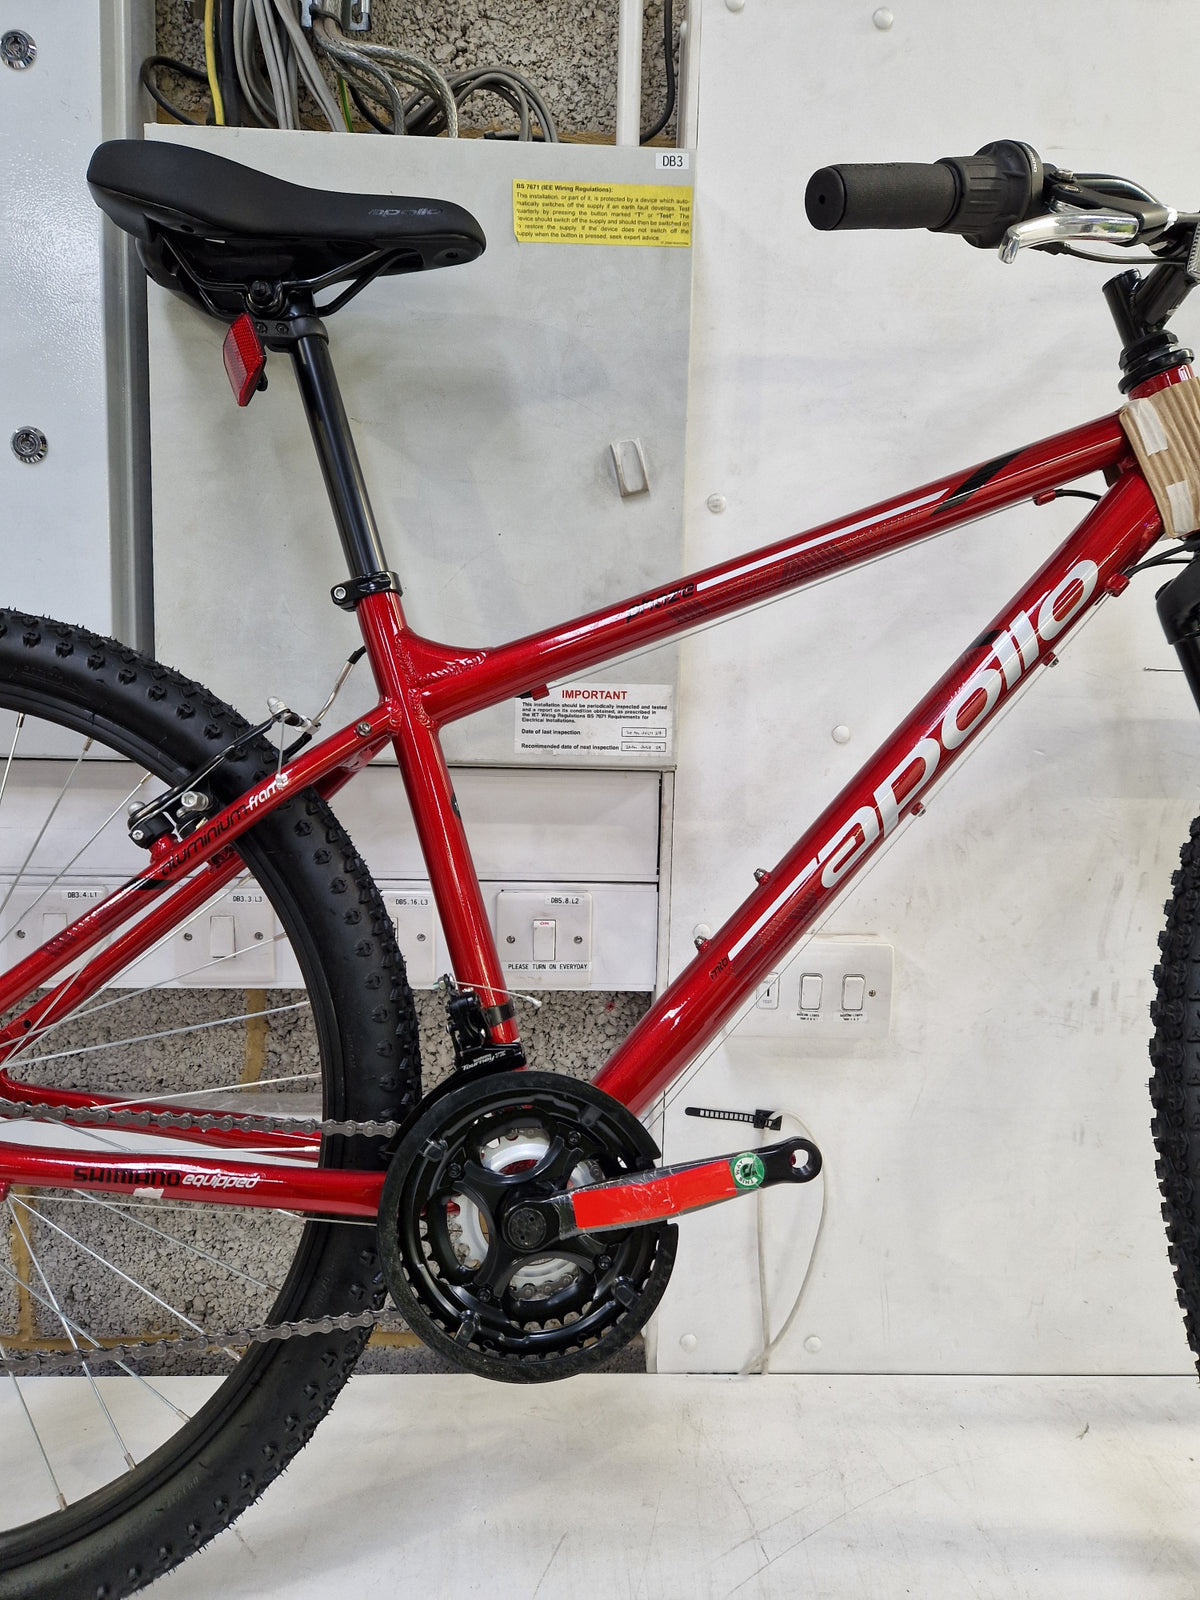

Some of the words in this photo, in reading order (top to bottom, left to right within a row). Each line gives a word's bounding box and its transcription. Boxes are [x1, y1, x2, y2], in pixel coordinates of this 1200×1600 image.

[662, 156, 684, 167] DB3
[562, 690, 627, 700] IMPORTANT
[820, 559, 1099, 889] apollo
[73, 1167, 180, 1187] SHIMANO
[182, 1173, 260, 1190] equipped
